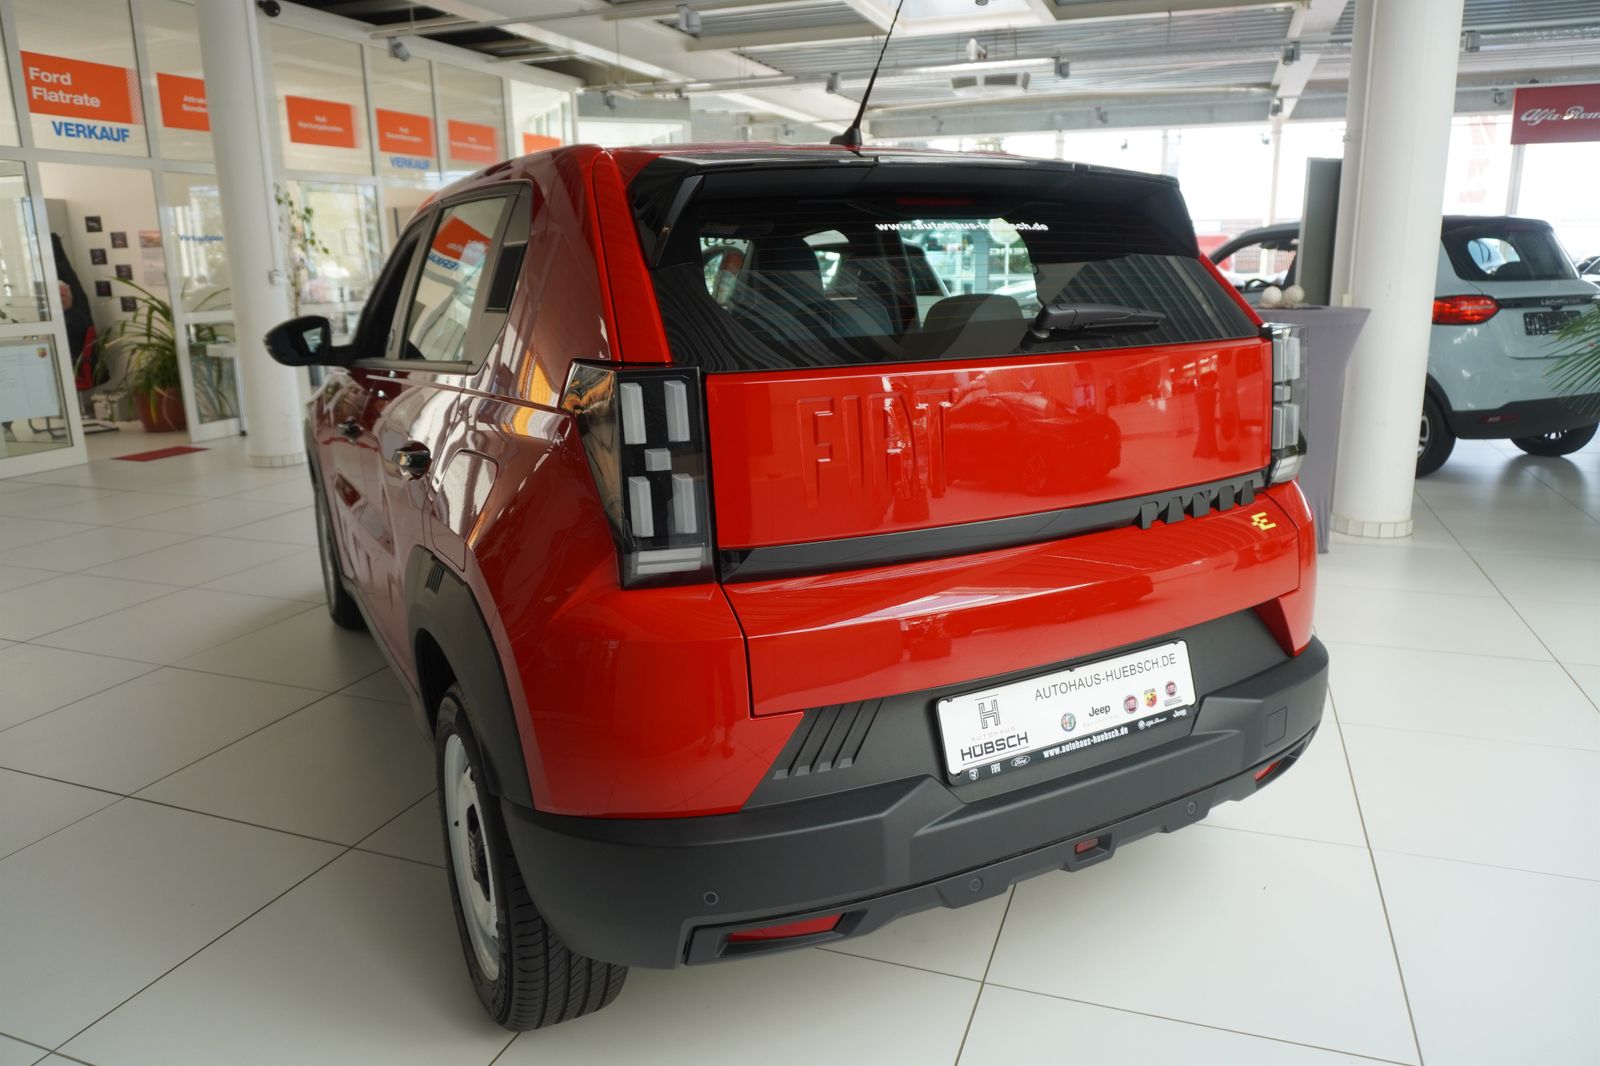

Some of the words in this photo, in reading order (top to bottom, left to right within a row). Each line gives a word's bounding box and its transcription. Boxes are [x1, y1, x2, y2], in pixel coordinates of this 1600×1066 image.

[28, 66, 72, 86] Ford
[32, 86, 101, 108] Flatrate
[1521, 108, 1560, 126] Alfa
[1562, 105, 1600, 121] Rom
[51, 120, 130, 143] VERKAUF
[390, 157, 431, 170] VERKAUF
[797, 388, 955, 508] FIAT
[1138, 480, 1255, 530] PANDA
[1035, 653, 1177, 701] AUTOHAUS-HUEBSCH.DE
[1088, 704, 1111, 718] Jeep
[1173, 708, 1187, 718] Jeep
[971, 726, 1016, 741] AUTOHAUS
[1043, 726, 1129, 759] www.autohaus-huebsch.de
[960, 732, 1029, 761] HÜBSCH
